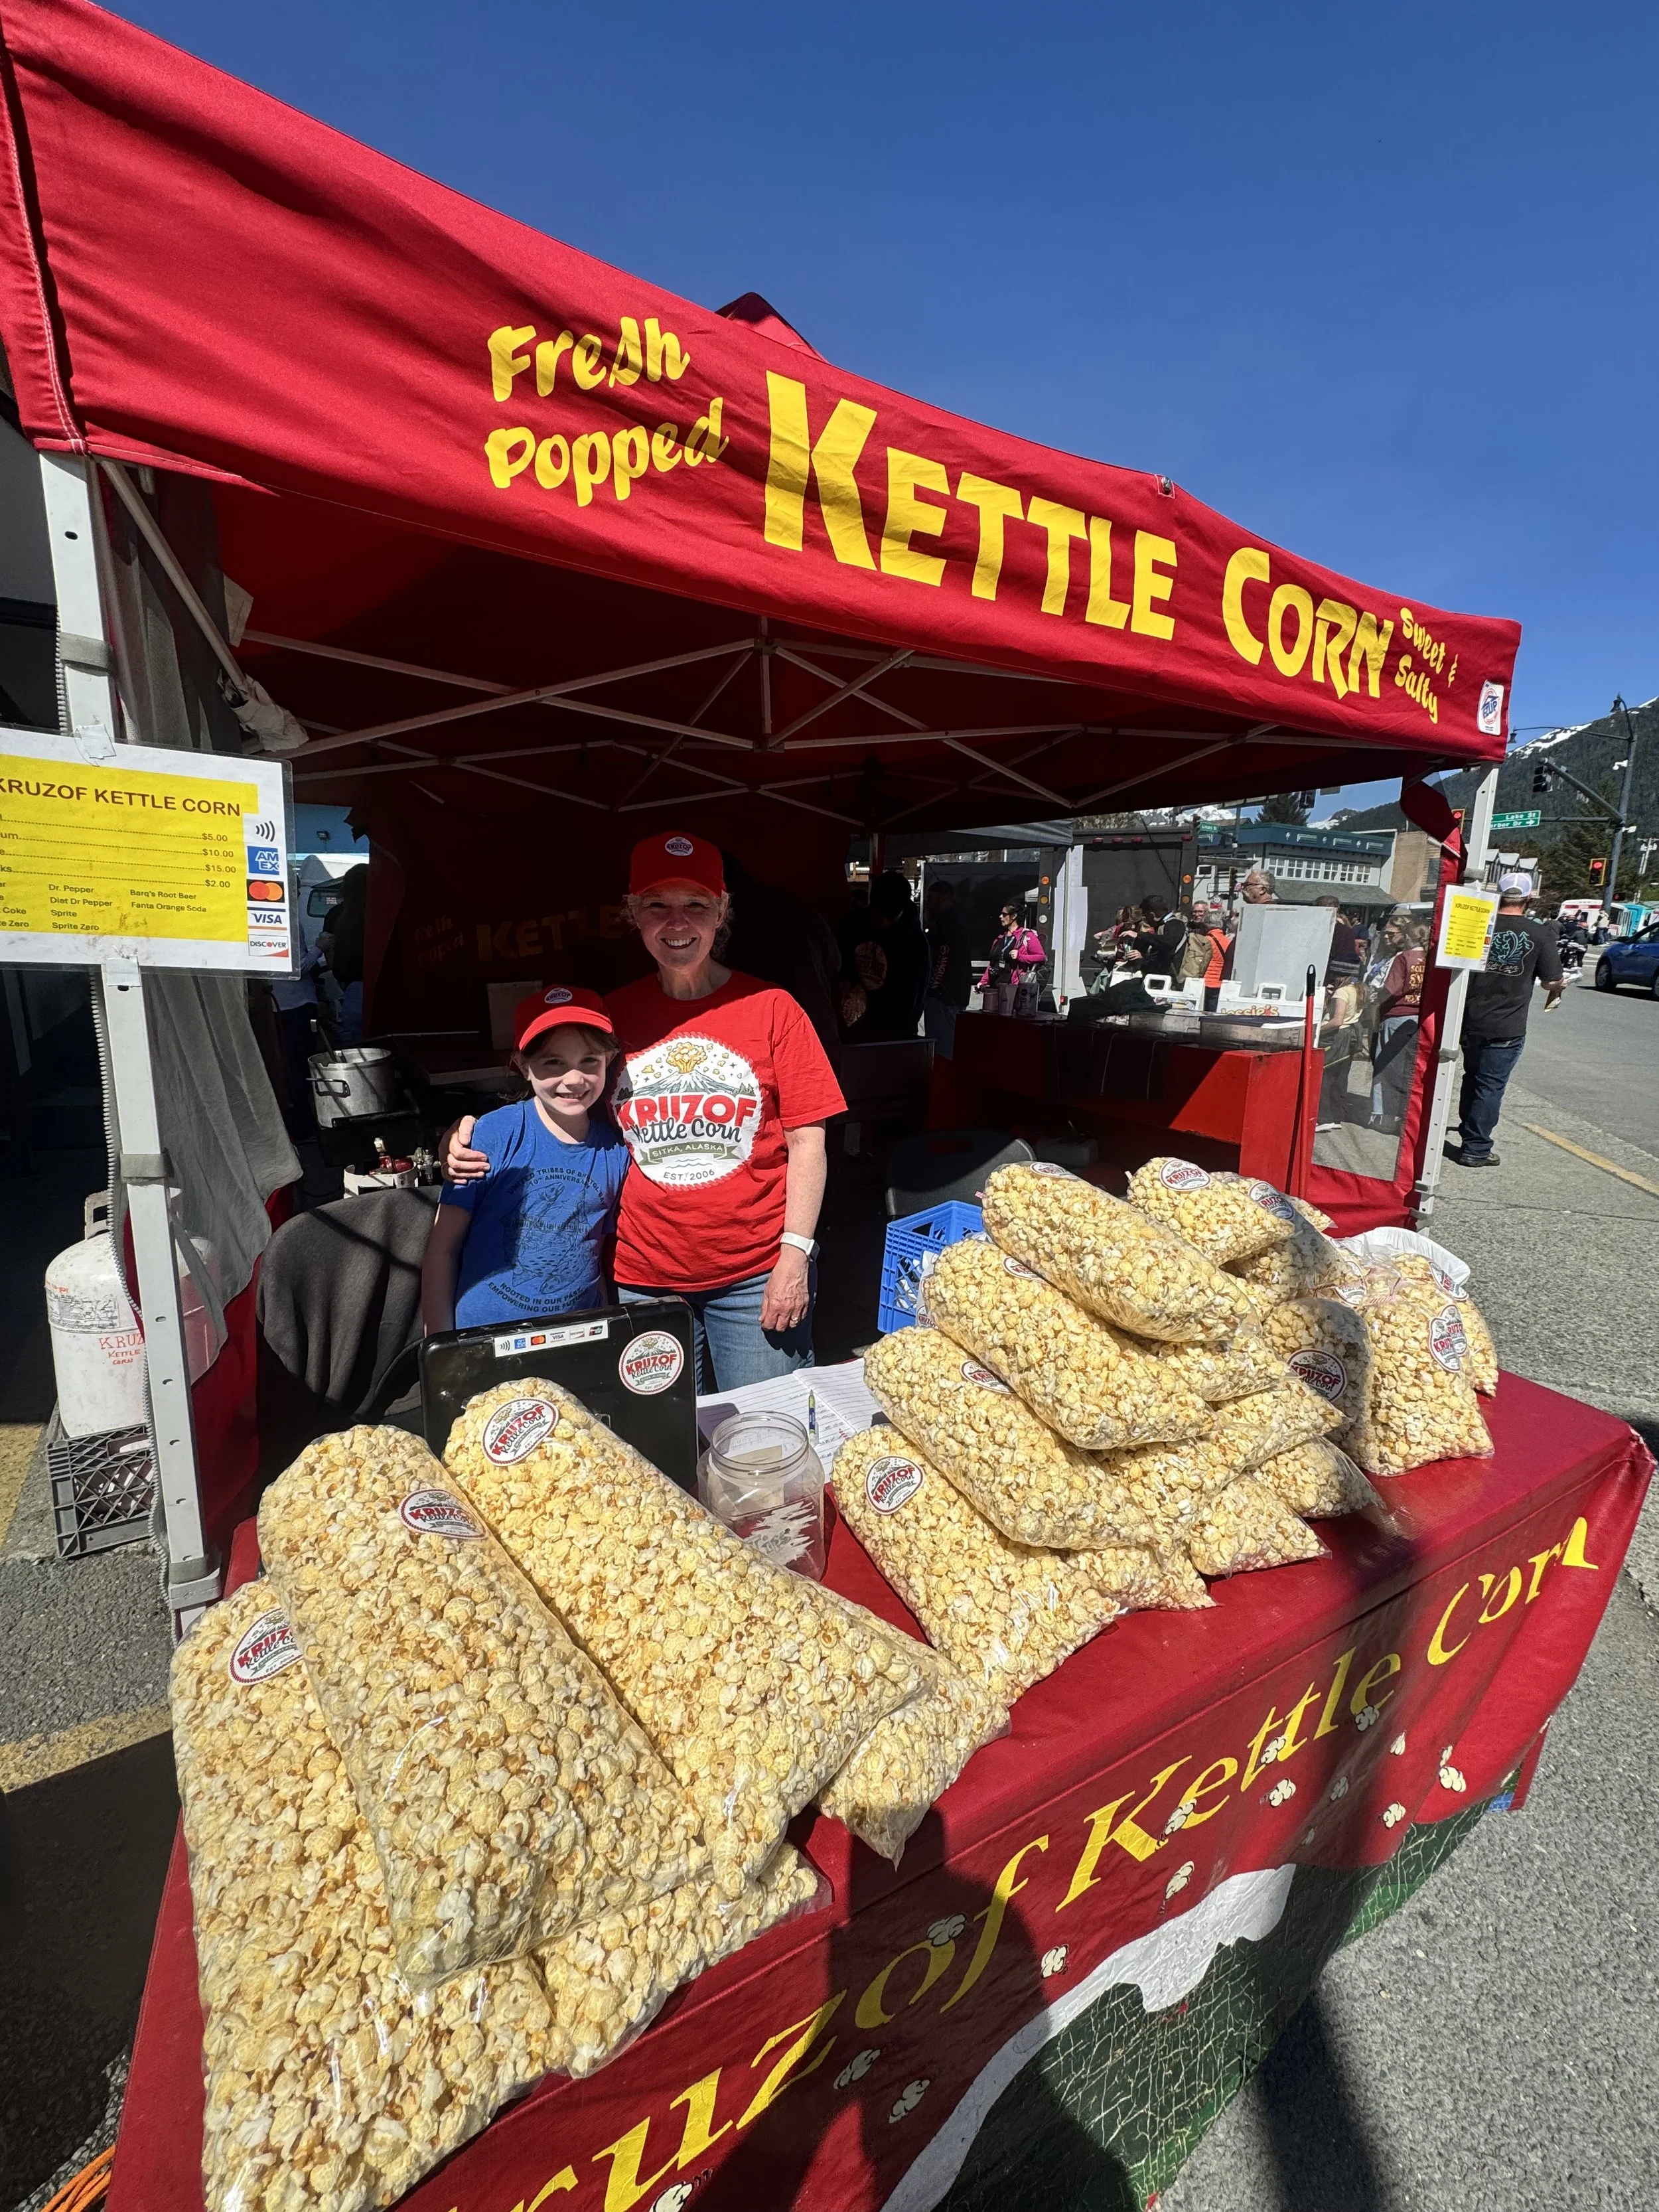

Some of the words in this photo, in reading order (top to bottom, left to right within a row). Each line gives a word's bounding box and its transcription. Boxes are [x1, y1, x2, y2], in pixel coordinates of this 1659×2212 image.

[487, 317, 691, 402] Fresh
[484, 398, 729, 507] Popped
[764, 370, 1177, 640] KETTLE
[1222, 547, 1394, 700] CORN
[1400, 607, 1445, 674] Sweet
[1448, 654, 1458, 688] &
[1394, 654, 1438, 724] Salty
[95, 788, 177, 810] KETTLE
[182, 798, 241, 817] CORN
[202, 833, 228, 842] $5.00
[202, 848, 234, 857] $10.00
[205, 864, 236, 873] $15.00
[63, 885, 94, 894] Pepper
[130, 889, 156, 898] Barq's
[204, 879, 231, 888] $2.00
[156, 903, 185, 912] Orange
[252, 913, 283, 924] VISA
[616, 1095, 757, 1131] KRUZOF
[630, 1117, 687, 1143] Kettle
[691, 1118, 741, 1143] Corn
[652, 1147, 683, 1157] SITKA,
[507, 1173, 535, 1195] UNITED
[690, 1169, 715, 1181] 2006
[488, 1282, 539, 1313] EMPOWERING
[500, 1282, 530, 1303] ROOTED
[108, 1349, 141, 1359] KETTLE
[626, 1354, 677, 1375] KRUZOF
[632, 1364, 653, 1379] Kettle
[492, 1405, 545, 1455] KRUZOF
[500, 1428, 524, 1453] Kettle
[523, 1412, 545, 1428] Corn
[873, 1467, 915, 1503] KRUZOF
[896, 1474, 914, 1484] Corn
[420, 1514, 453, 1522] Kettle
[238, 1628, 293, 1668] KRUZ
[246, 1641, 280, 1669] Kettle
[282, 1635, 296, 1645] Co
[510, 1832, 1048, 2212] ruzof
[1055, 1649, 1402, 1914] Kettle
[1426, 1515, 1599, 1666] Corn
